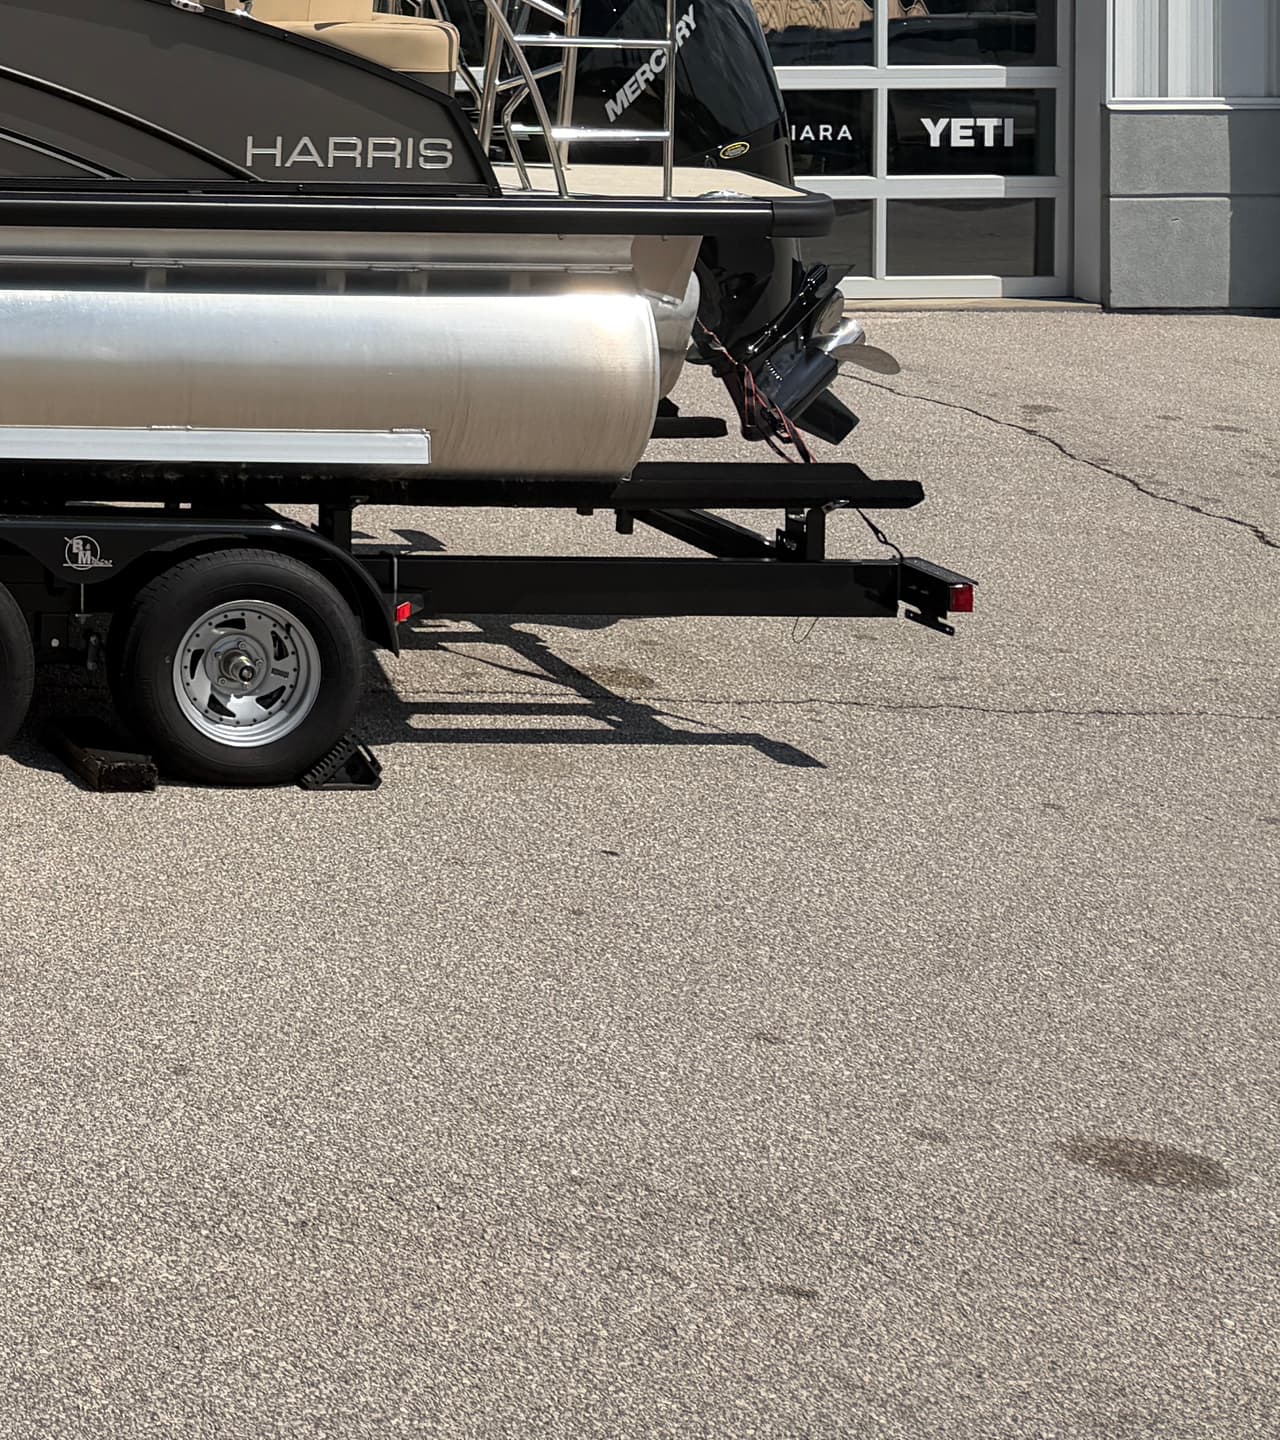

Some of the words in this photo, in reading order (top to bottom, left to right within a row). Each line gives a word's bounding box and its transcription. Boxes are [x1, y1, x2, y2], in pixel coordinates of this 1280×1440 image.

[604, 3, 697, 123] MERCRY
[790, 124, 853, 141] IARA
[920, 117, 1015, 148] YETI
[245, 135, 454, 169] HARRIS
